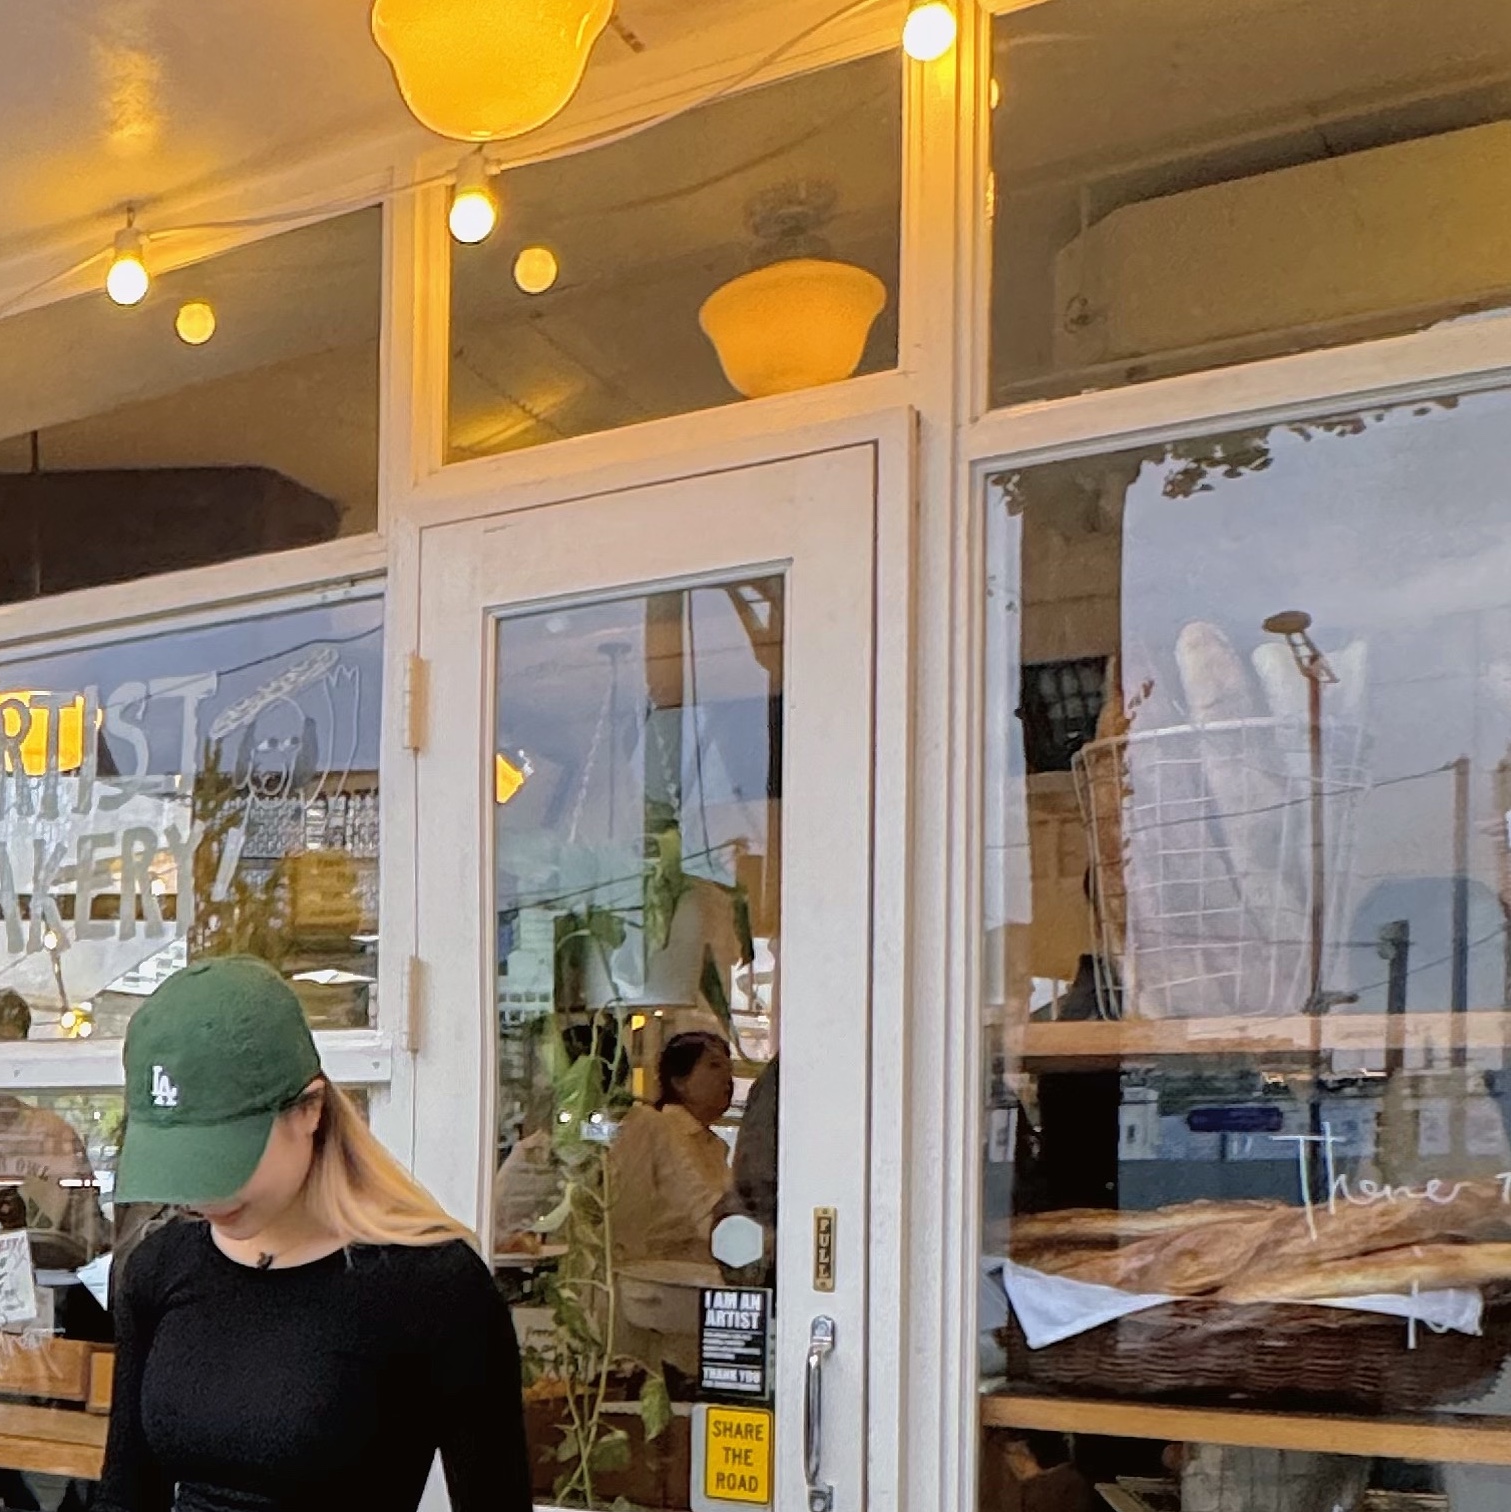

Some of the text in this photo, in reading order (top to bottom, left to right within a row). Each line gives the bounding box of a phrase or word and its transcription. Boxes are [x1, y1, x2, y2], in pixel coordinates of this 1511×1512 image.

[150, 1065, 178, 1106] LA
[817, 1217, 832, 1279] PULL
[704, 1290, 761, 1311] I AM AN
[704, 1309, 761, 1329] ARTIST
[712, 1420, 764, 1442] SHARE
[722, 1446, 754, 1467] THE
[715, 1472, 759, 1493] ROAD
